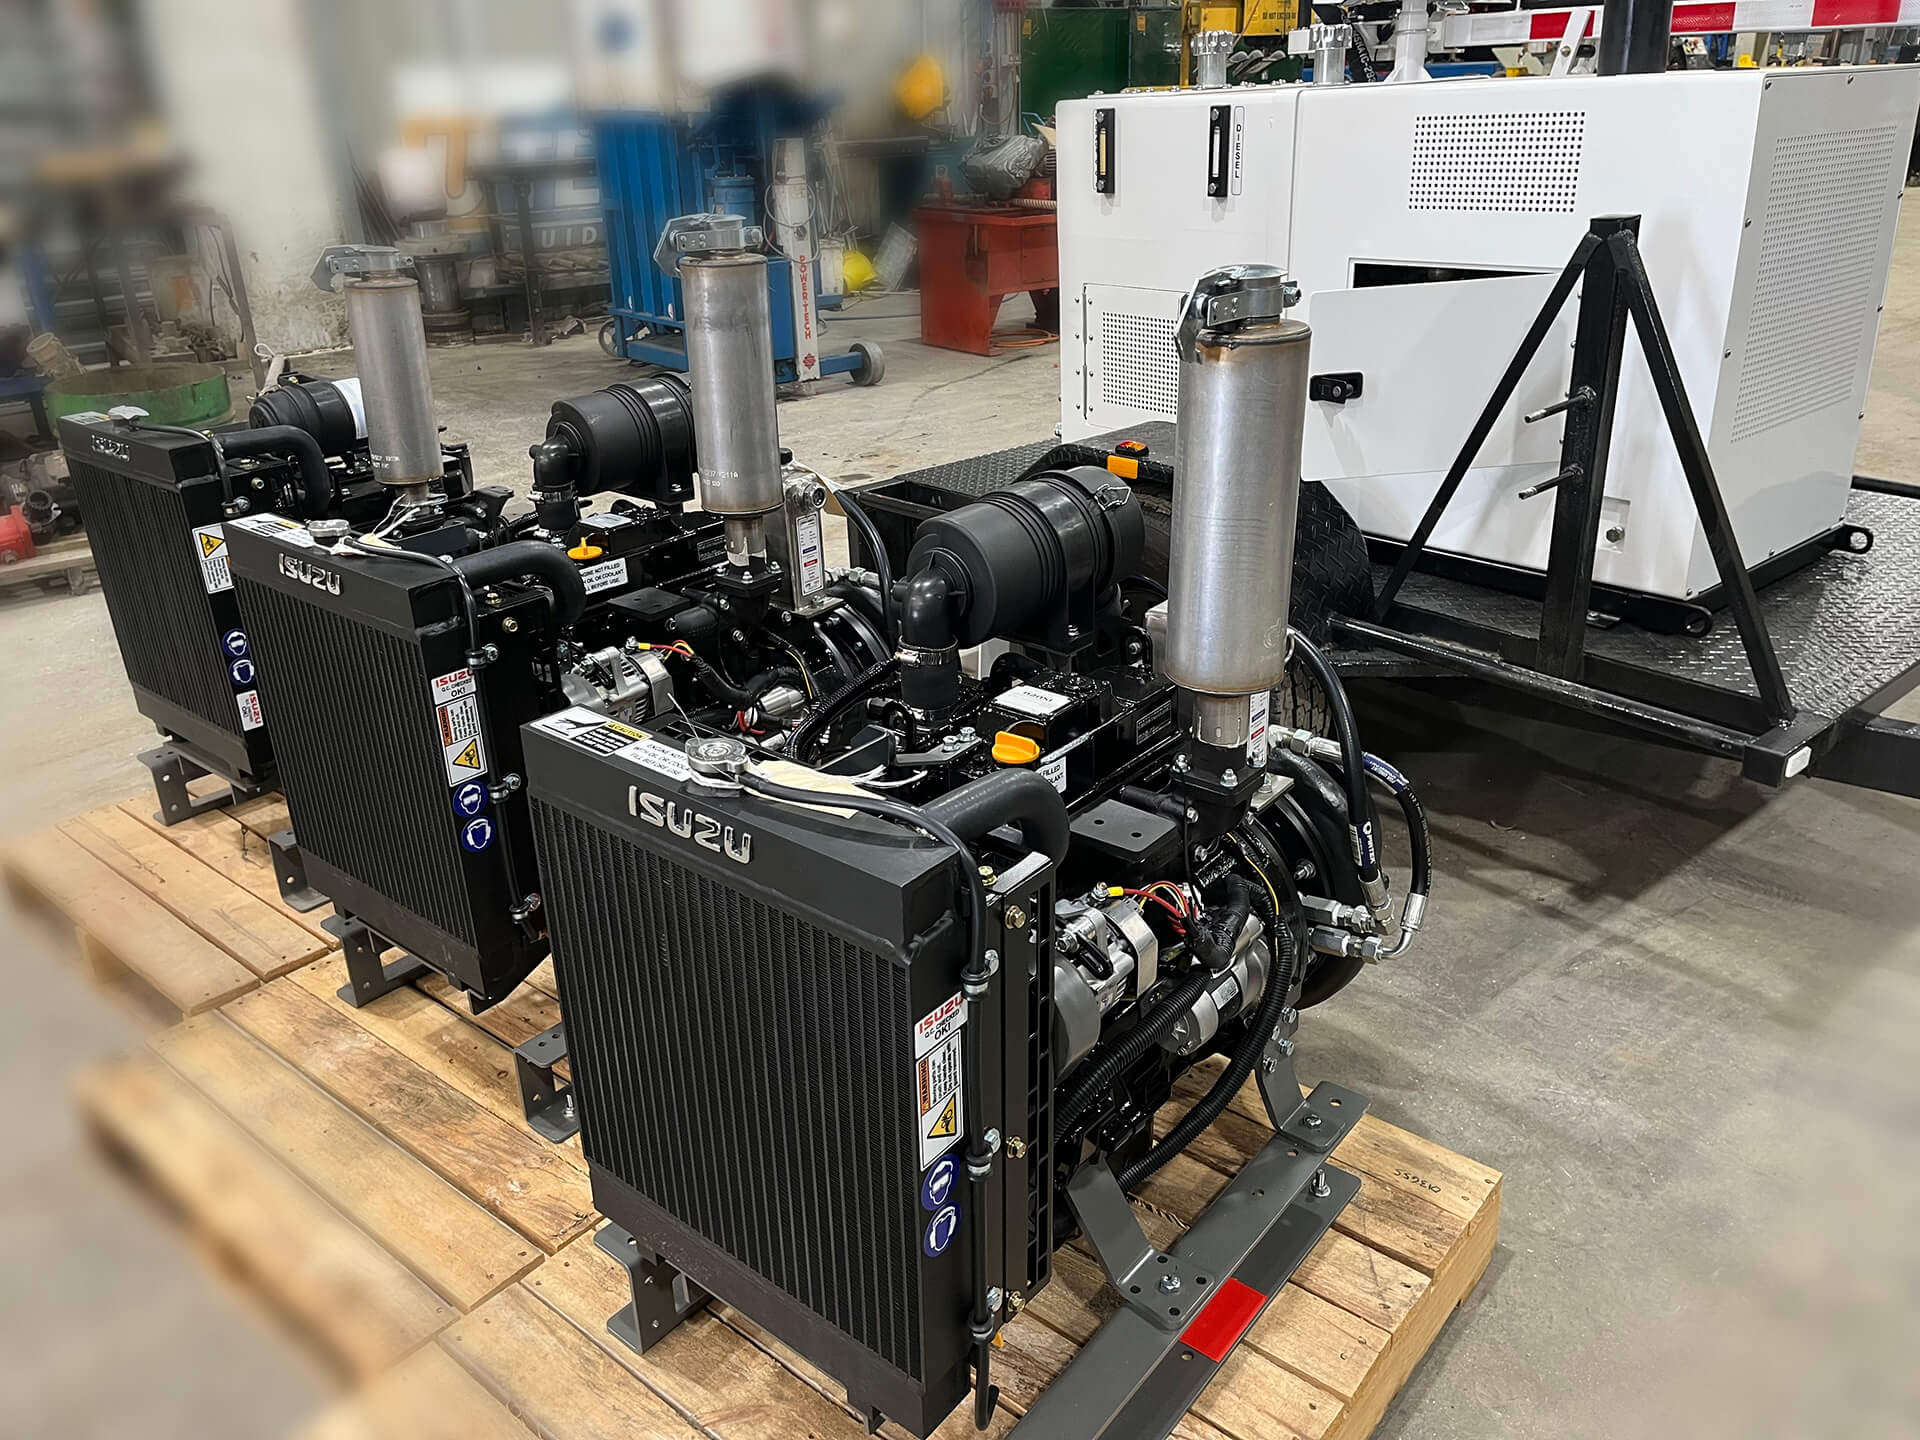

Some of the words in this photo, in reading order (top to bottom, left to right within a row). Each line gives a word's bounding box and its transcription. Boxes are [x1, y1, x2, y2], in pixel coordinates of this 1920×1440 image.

[541, 226, 597, 248] UID
[91, 434, 130, 461] ISUZU
[279, 553, 340, 595] ISUZU
[436, 670, 475, 688] ISUZU
[451, 687, 465, 697] OK!
[249, 693, 261, 724] ISUZU
[1043, 764, 1061, 776] FILLED
[629, 785, 751, 864] ISUZU
[1366, 834, 1376, 864] PIRTEK
[919, 995, 964, 1034] ISUZU
[934, 1022, 951, 1040] OK!
